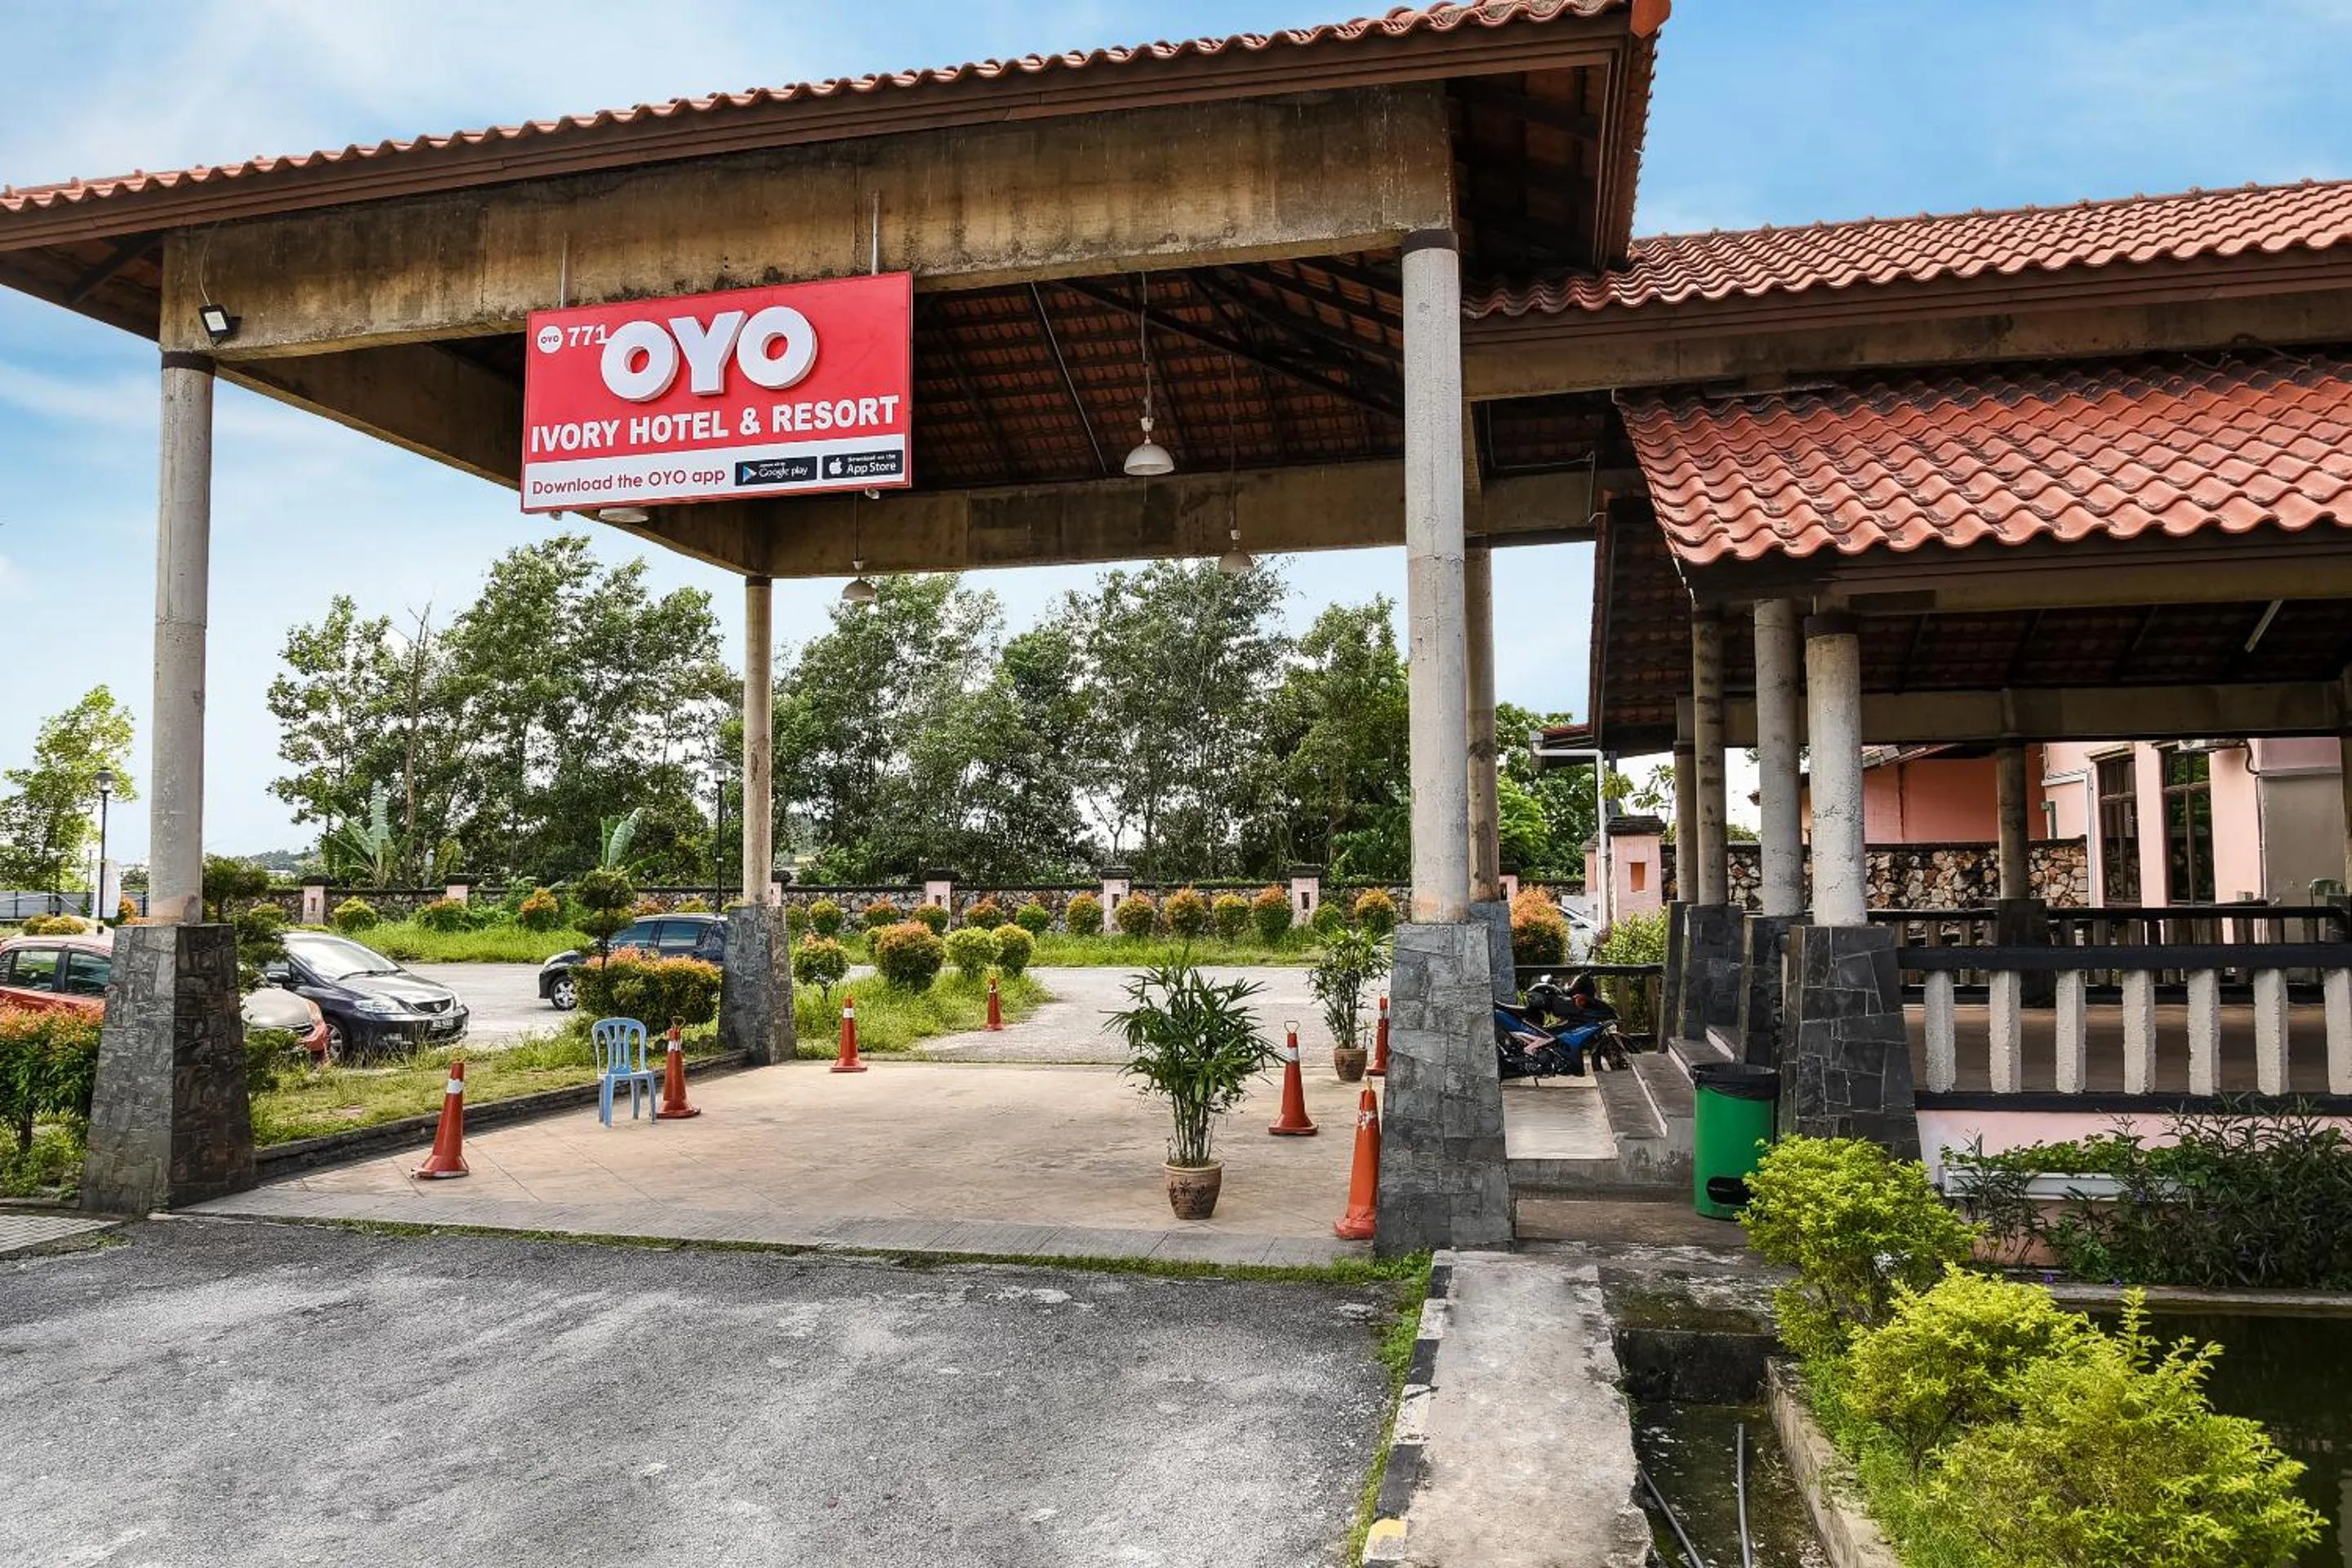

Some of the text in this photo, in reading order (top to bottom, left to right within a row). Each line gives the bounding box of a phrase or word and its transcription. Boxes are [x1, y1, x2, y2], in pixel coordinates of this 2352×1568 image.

[541, 335, 559, 344] OYO
[568, 324, 609, 347] 771
[600, 305, 818, 403] OYO
[531, 394, 899, 452] IVORY HOTEL & RESORT
[759, 466, 808, 479] Google play
[846, 461, 897, 475] App Store
[532, 470, 725, 494] Download the OYO app
